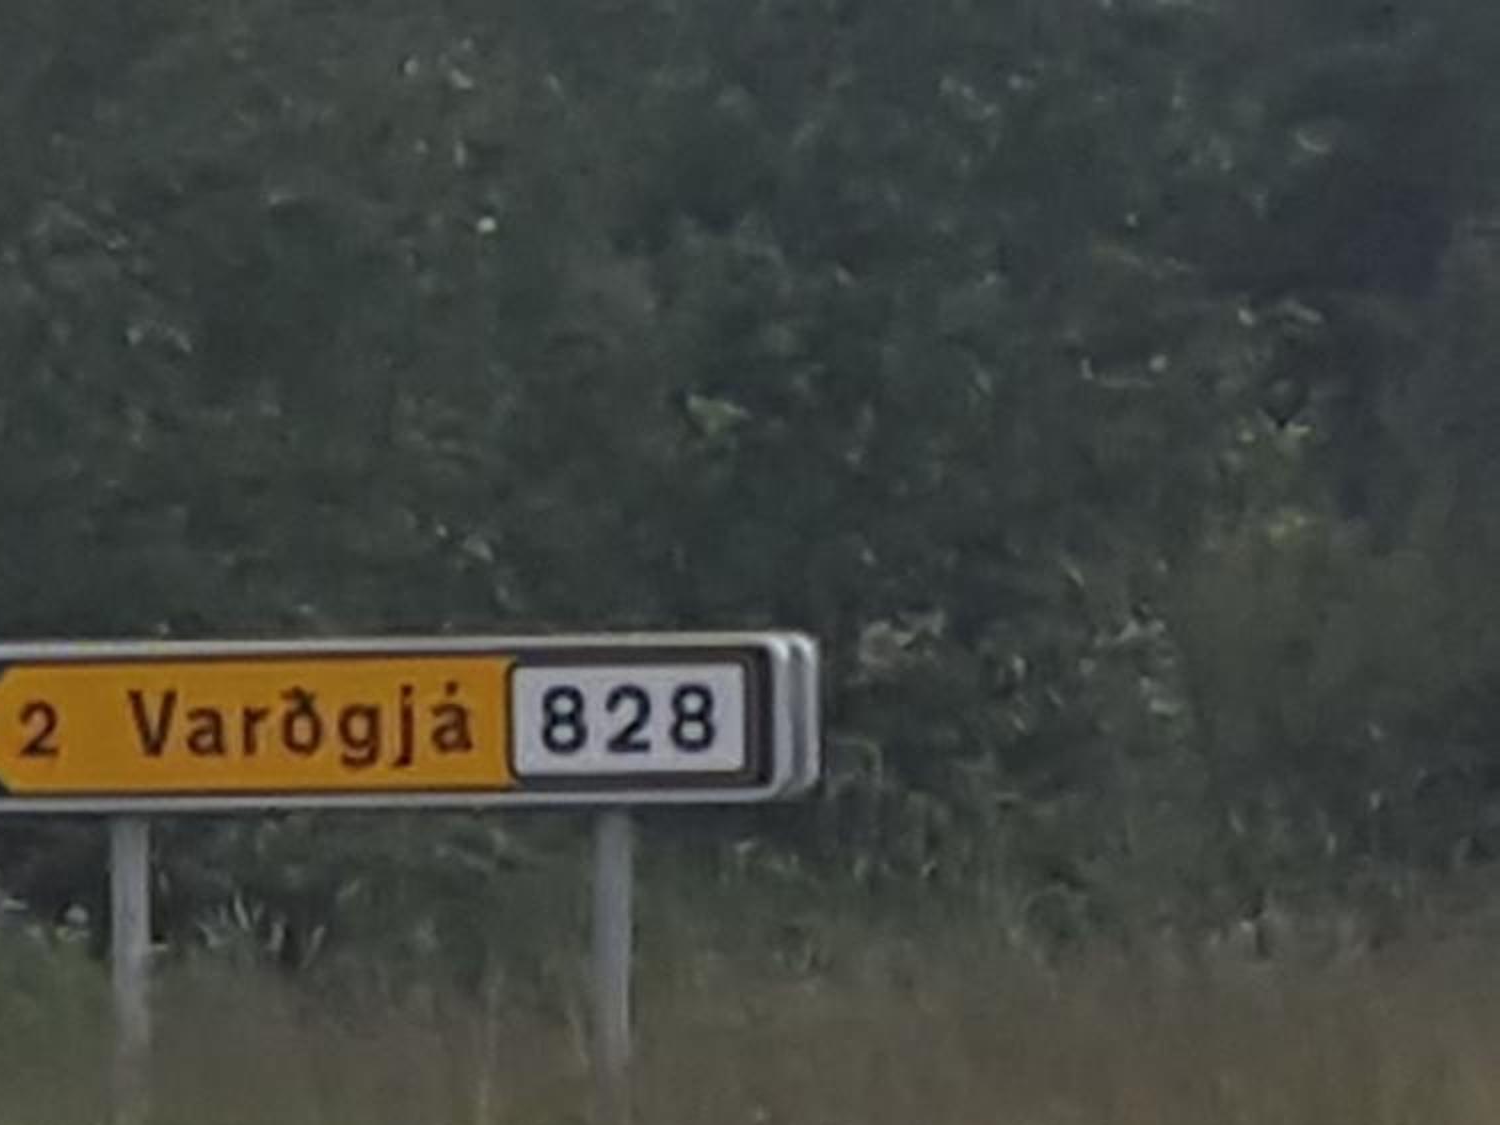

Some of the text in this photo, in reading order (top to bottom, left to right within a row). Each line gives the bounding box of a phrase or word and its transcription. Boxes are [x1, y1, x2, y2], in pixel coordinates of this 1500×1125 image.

[18, 682, 716, 769] 2 Varðgjá 828
